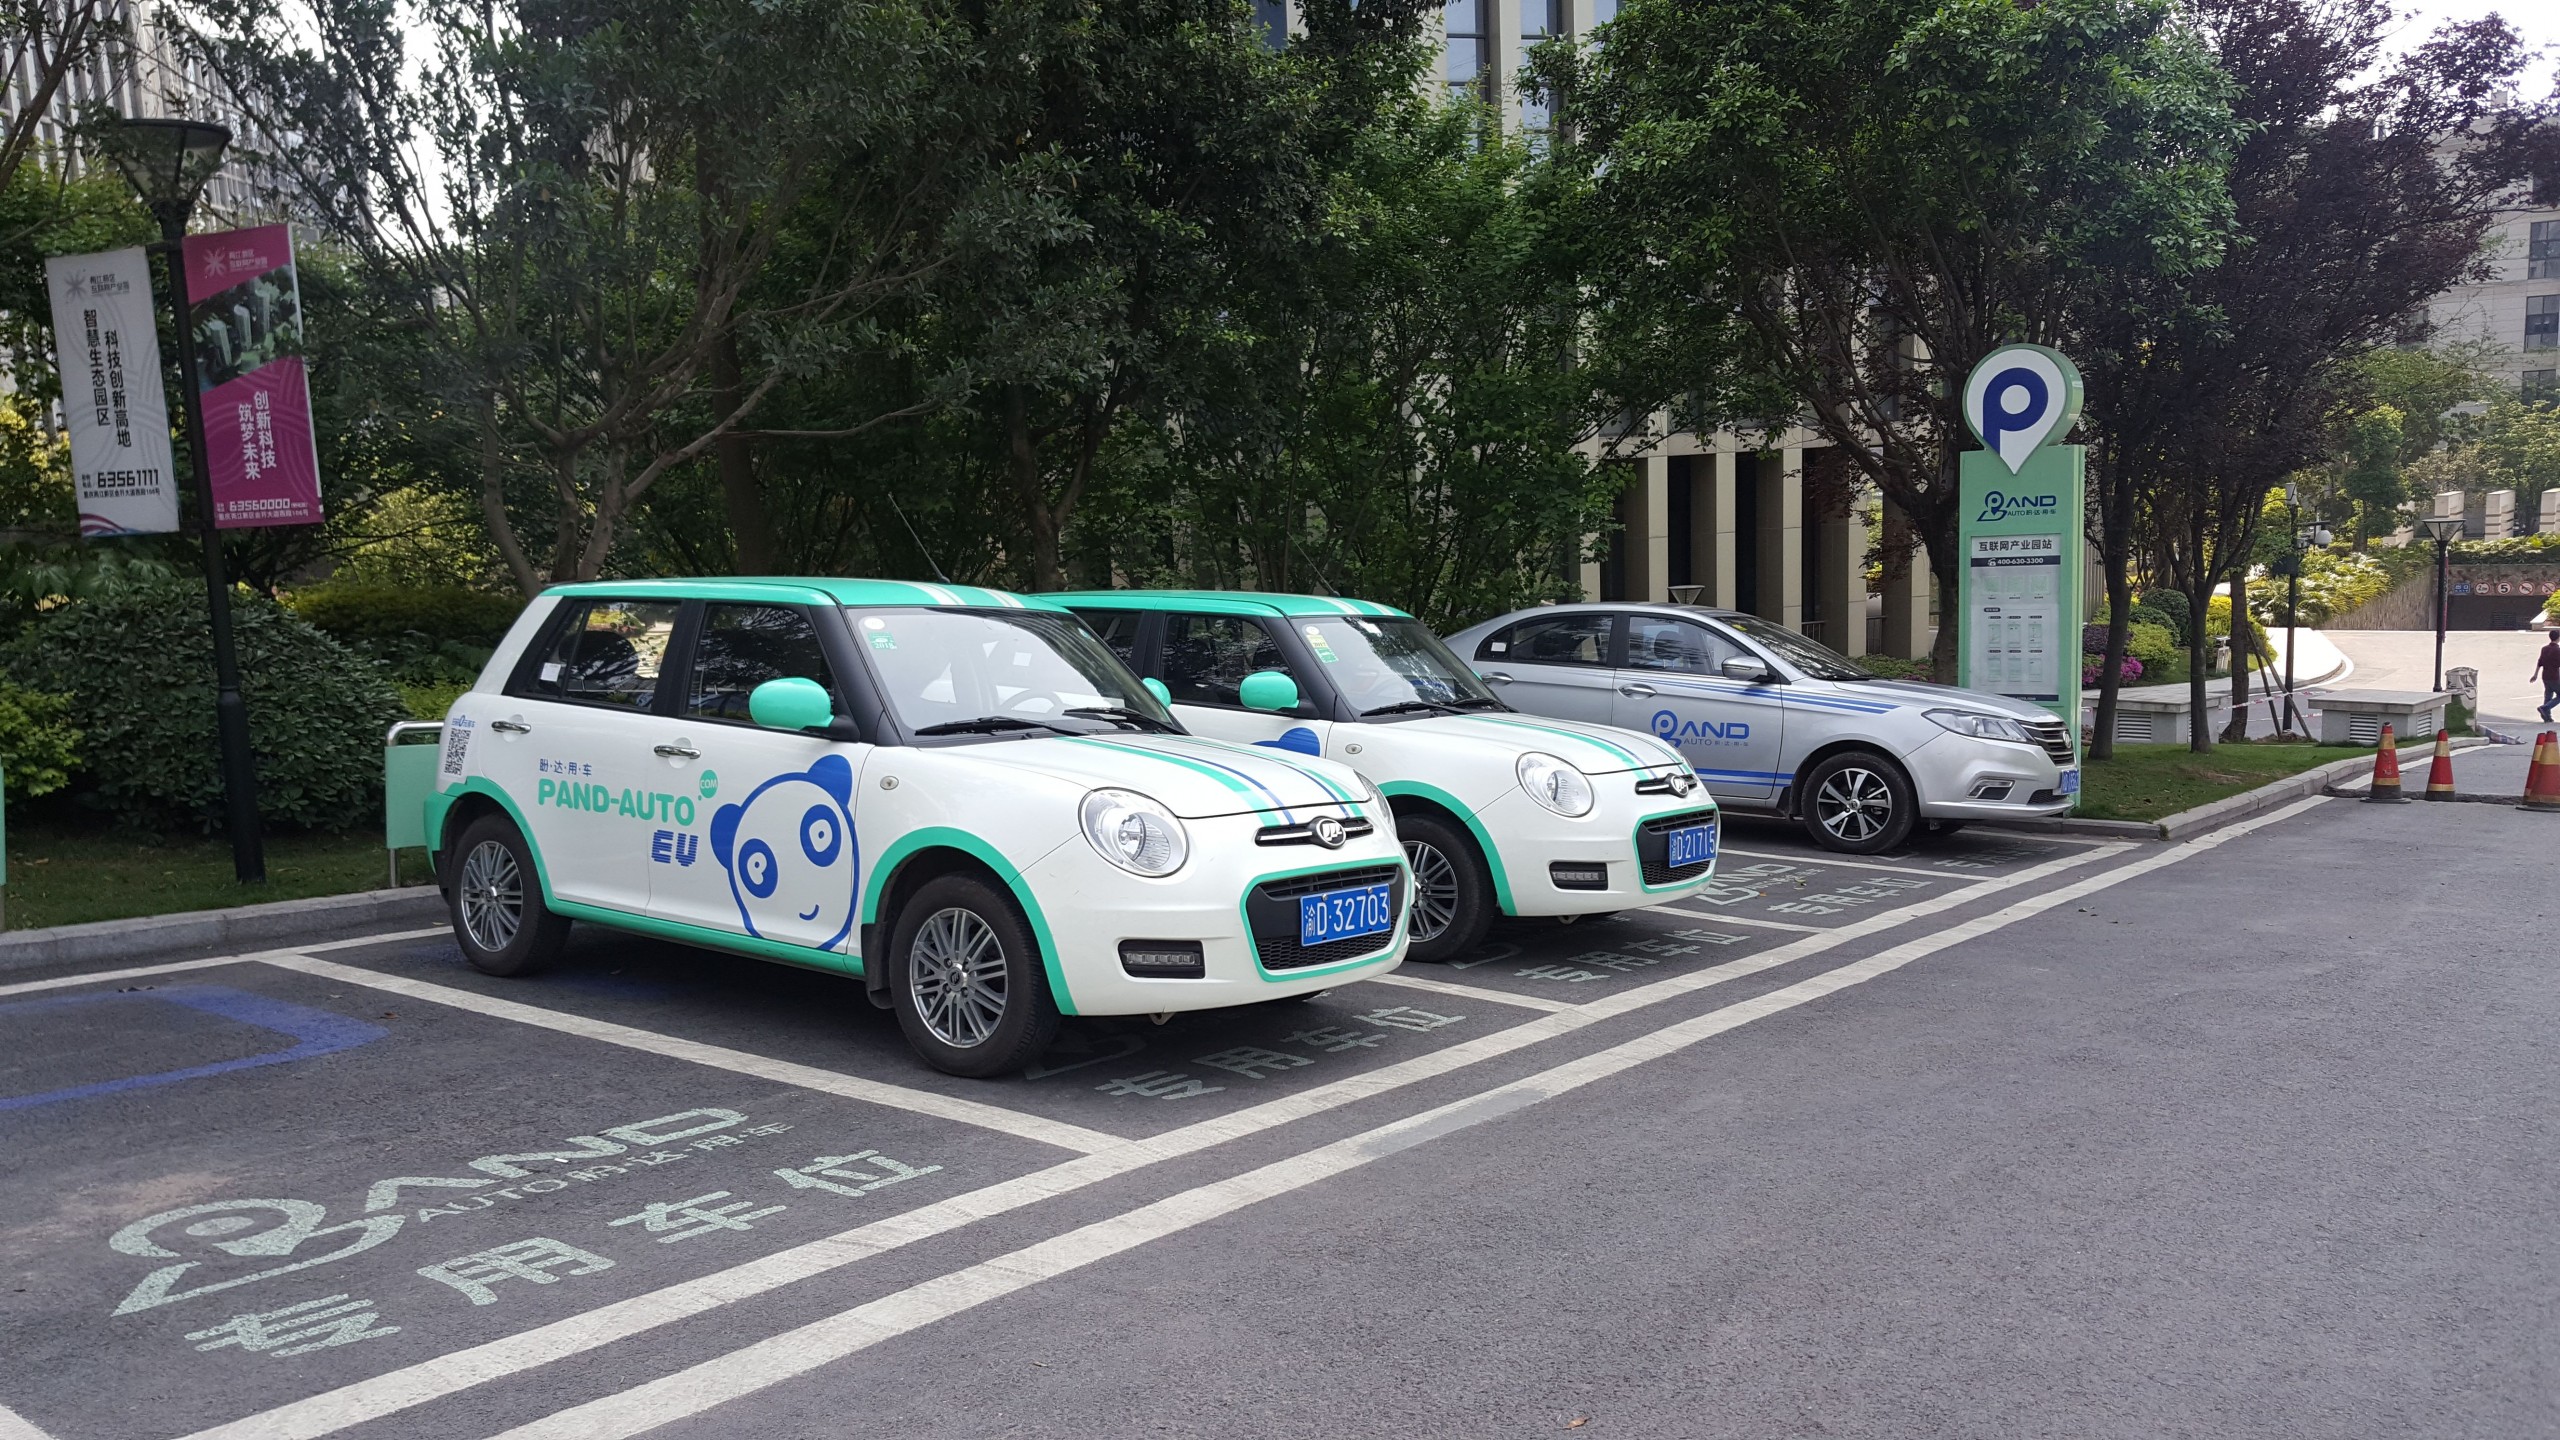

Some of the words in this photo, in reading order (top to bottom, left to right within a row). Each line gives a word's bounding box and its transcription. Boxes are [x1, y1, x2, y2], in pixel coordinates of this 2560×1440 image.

[83, 308, 111, 427] 智慧生态园区
[104, 330, 132, 448] 科技创新高地
[238, 403, 261, 481] 筑梦未来
[253, 391, 277, 469] 创新科技
[98, 469, 159, 488] 63561111
[229, 498, 290, 512] 63560000
[1979, 539, 2053, 552] 互联网产业园站
[1997, 557, 2044, 565] 400-630-3300
[2500, 584, 2508, 593] 5
[1683, 738, 1712, 746] AUTO
[538, 778, 696, 827] PAND-AUTO
[651, 829, 699, 867] EU
[1095, 1006, 1467, 1100] 专用车位
[418, 1179, 569, 1223] AUTO
[184, 1149, 944, 1358] 专用车位
